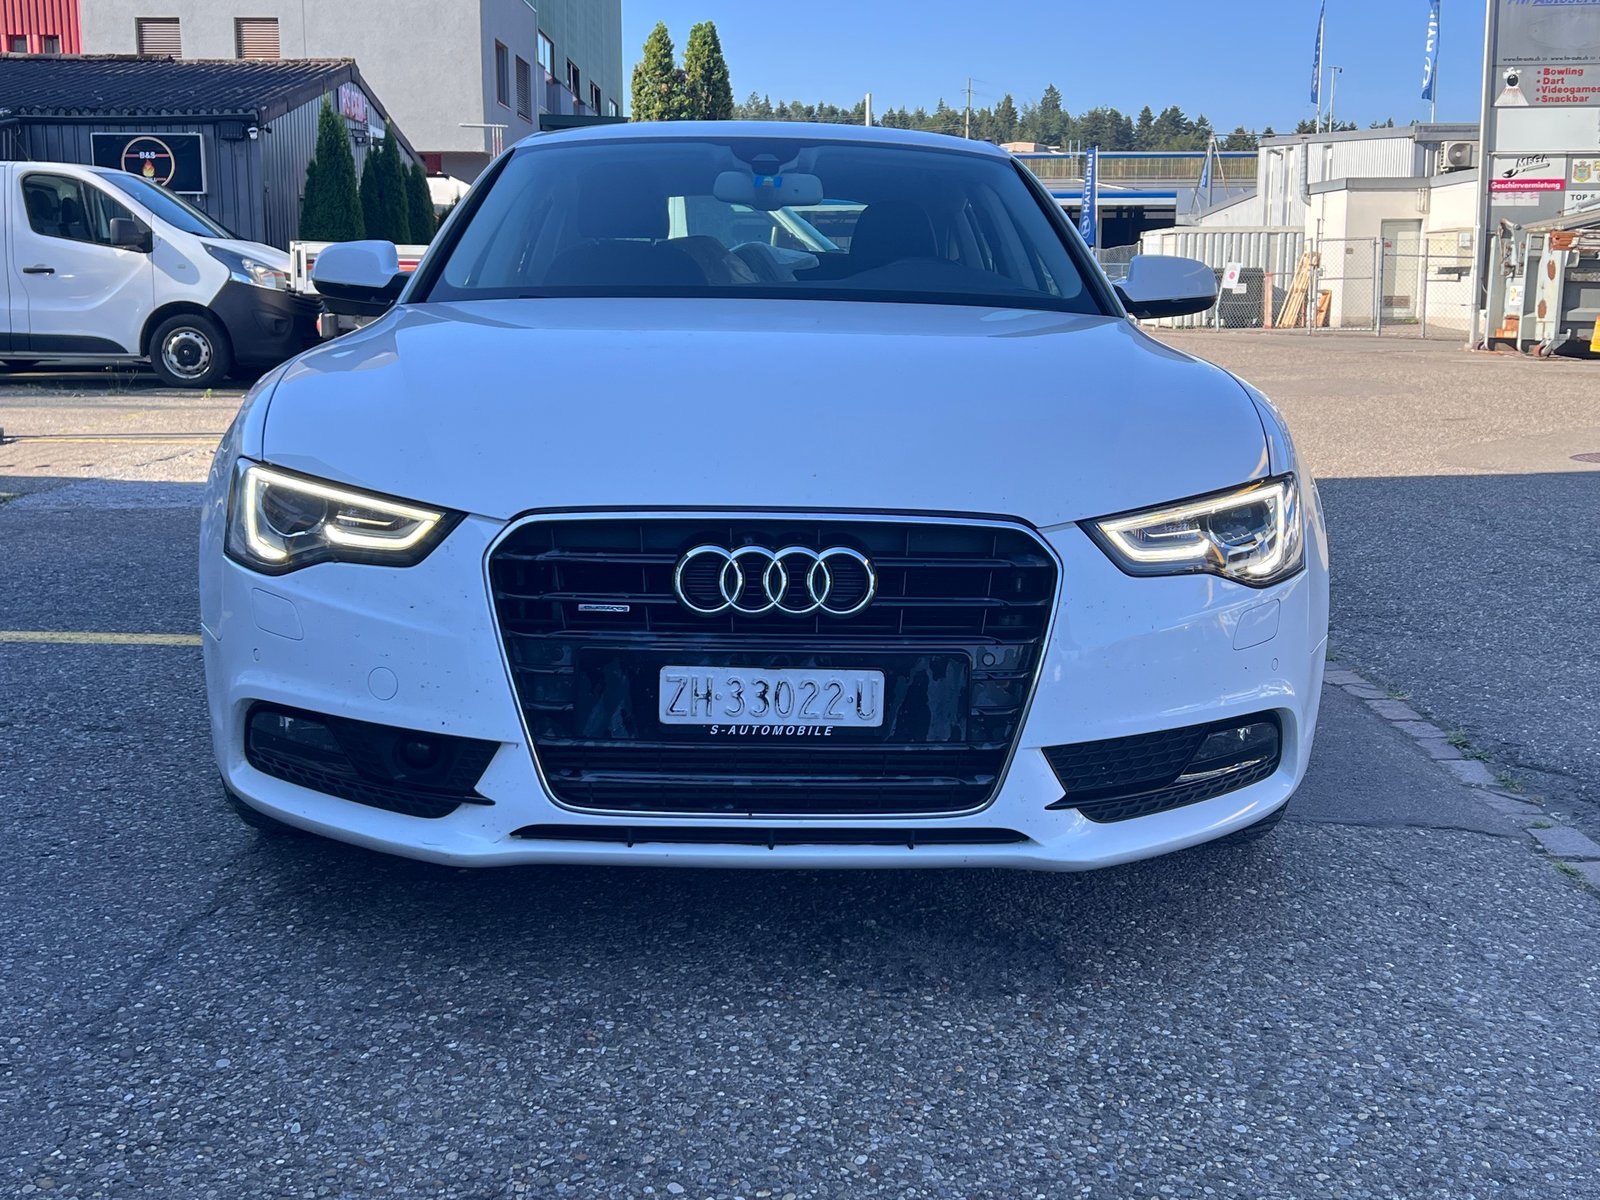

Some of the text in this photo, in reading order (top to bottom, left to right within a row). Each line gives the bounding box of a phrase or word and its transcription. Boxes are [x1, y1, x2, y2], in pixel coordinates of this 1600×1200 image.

[1543, 68, 1584, 76] Bowling
[1543, 77, 1565, 85] Dart
[1541, 86, 1600, 94] Videogames
[1541, 95, 1589, 103] Snackbar
[139, 151, 156, 159] B&S
[1491, 181, 1561, 190] Geschirrvermietung
[710, 724, 835, 737] S-AUTOMOBILE
